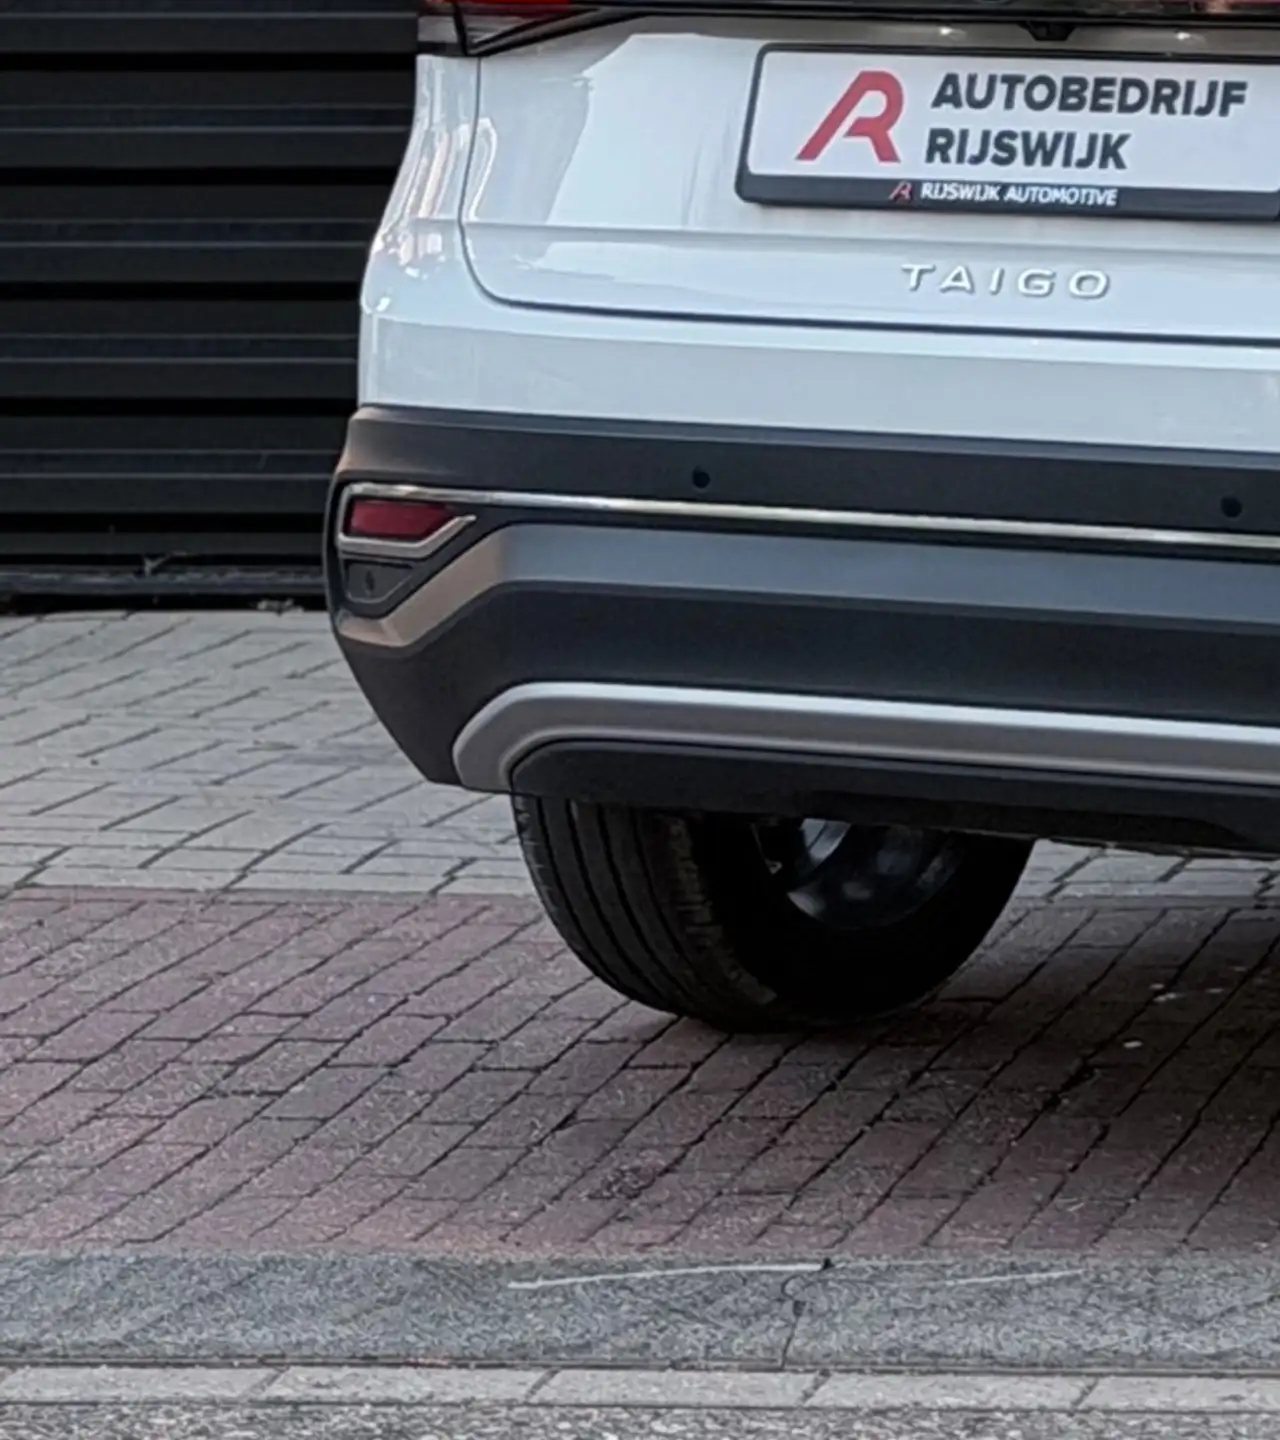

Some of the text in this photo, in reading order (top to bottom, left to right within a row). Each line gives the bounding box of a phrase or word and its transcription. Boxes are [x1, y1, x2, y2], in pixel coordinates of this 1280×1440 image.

[931, 72, 1248, 118] AUTOBEDRIJF
[925, 127, 1131, 170] RIJSWIJK
[920, 181, 1000, 202] RIJSWIJK
[1003, 185, 1119, 207] AUTOMOTIVE
[901, 263, 1109, 299] TAIGO
